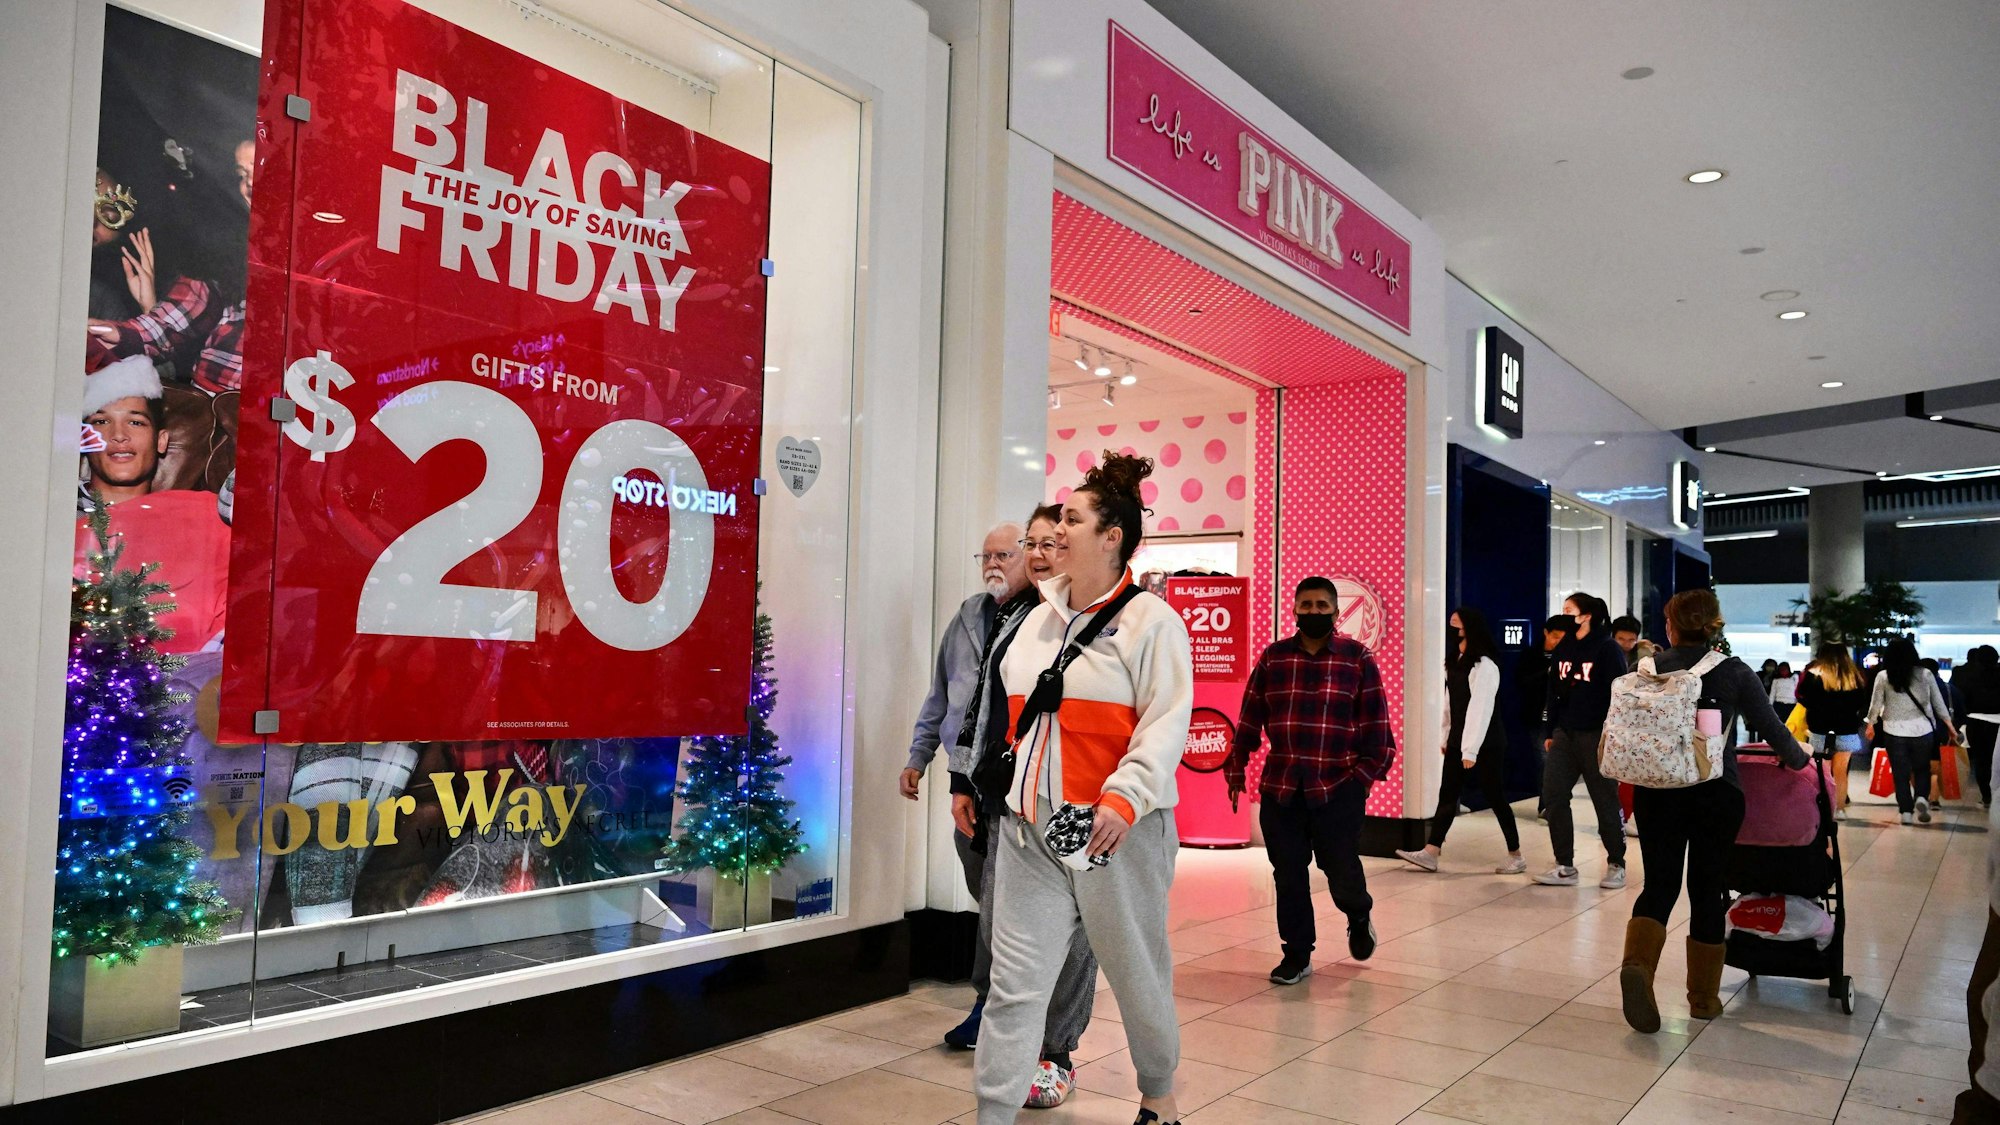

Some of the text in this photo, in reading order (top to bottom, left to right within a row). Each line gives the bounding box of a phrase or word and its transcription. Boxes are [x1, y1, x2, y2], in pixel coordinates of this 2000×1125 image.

[392, 68, 693, 255] BLACK
[424, 172, 672, 251] THE JOY OF SAVING
[1140, 94, 1401, 295] life is PINK is life
[377, 164, 697, 332] FRIDAY
[1258, 229, 1321, 275] VICTORIA'S SECRET
[471, 353, 619, 406] GIFTS FROM
[1501, 352, 1520, 397] GAP
[283, 350, 715, 651] $20
[1174, 587, 1206, 595] BLACK
[1208, 586, 1242, 595] FRIDAY
[1182, 606, 1231, 632] $20
[1211, 636, 1233, 644] BRAS
[1504, 630, 1523, 645] GAP
[1195, 645, 1220, 653] SLEEP
[1184, 741, 1228, 754] FRIDAY
[1187, 731, 1227, 742] BLACK
[232, 771, 265, 780] NATION
[205, 768, 587, 861] Your Way
[416, 809, 650, 849] VICTORIA'S SECRET
